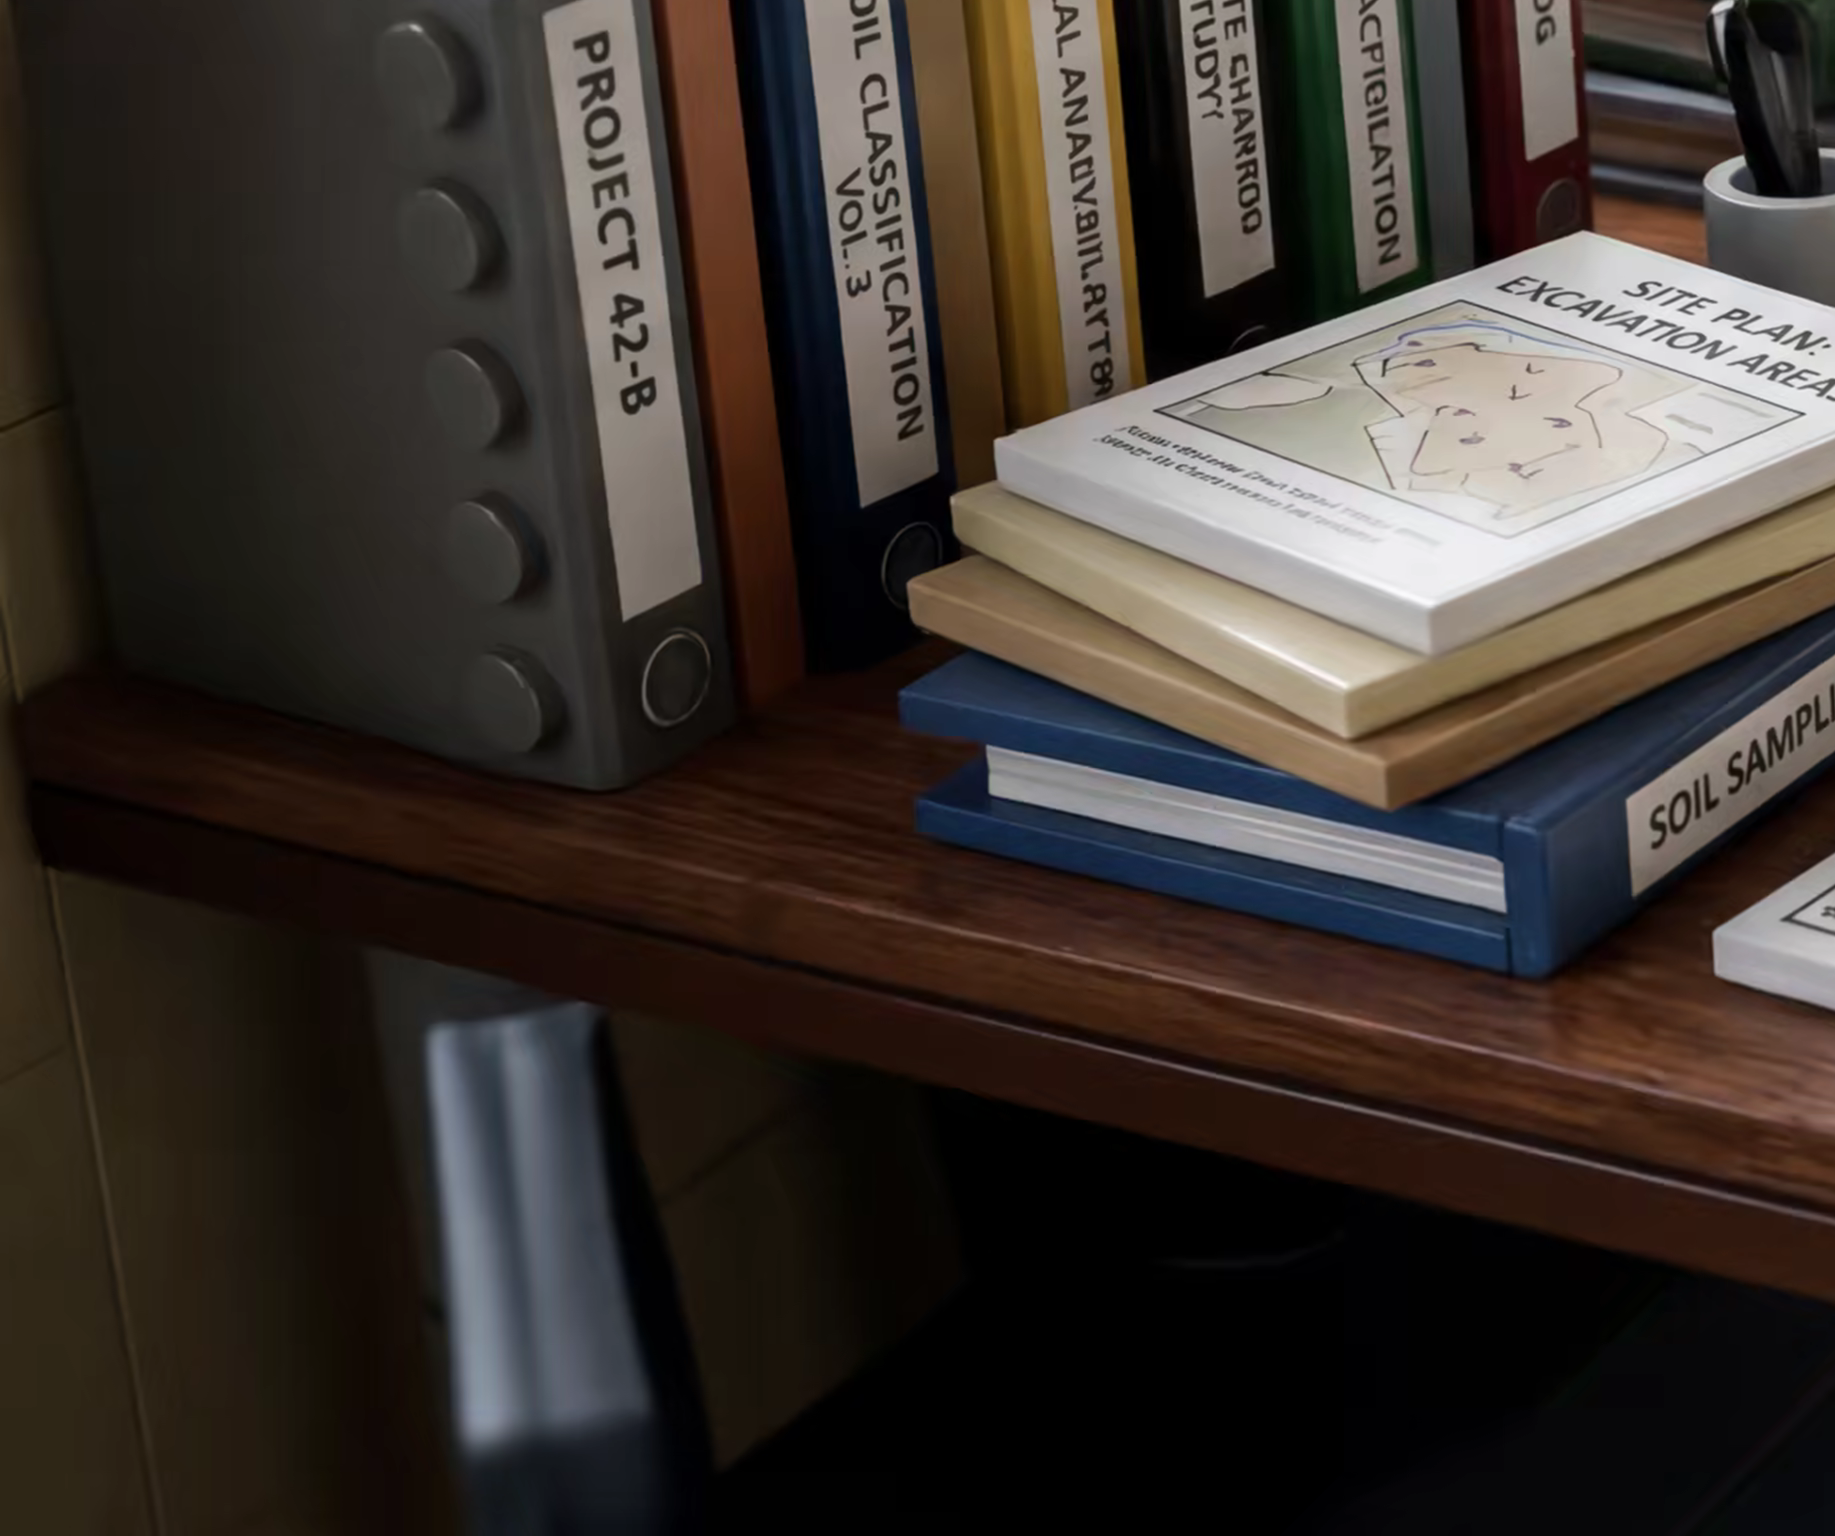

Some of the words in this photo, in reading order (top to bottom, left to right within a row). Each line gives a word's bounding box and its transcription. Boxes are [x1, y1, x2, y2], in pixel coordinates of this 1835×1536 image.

[572, 29, 640, 271] PROJECT
[609, 292, 658, 416] 42-B
[858, 72, 925, 442] CLASSIFICATION
[845, 269, 873, 299] 3
[1495, 275, 1738, 361] EXCAVATION
[1622, 280, 1718, 317] SITE
[1710, 307, 1832, 357] PLAN:
[1649, 772, 1720, 850] SOIL
